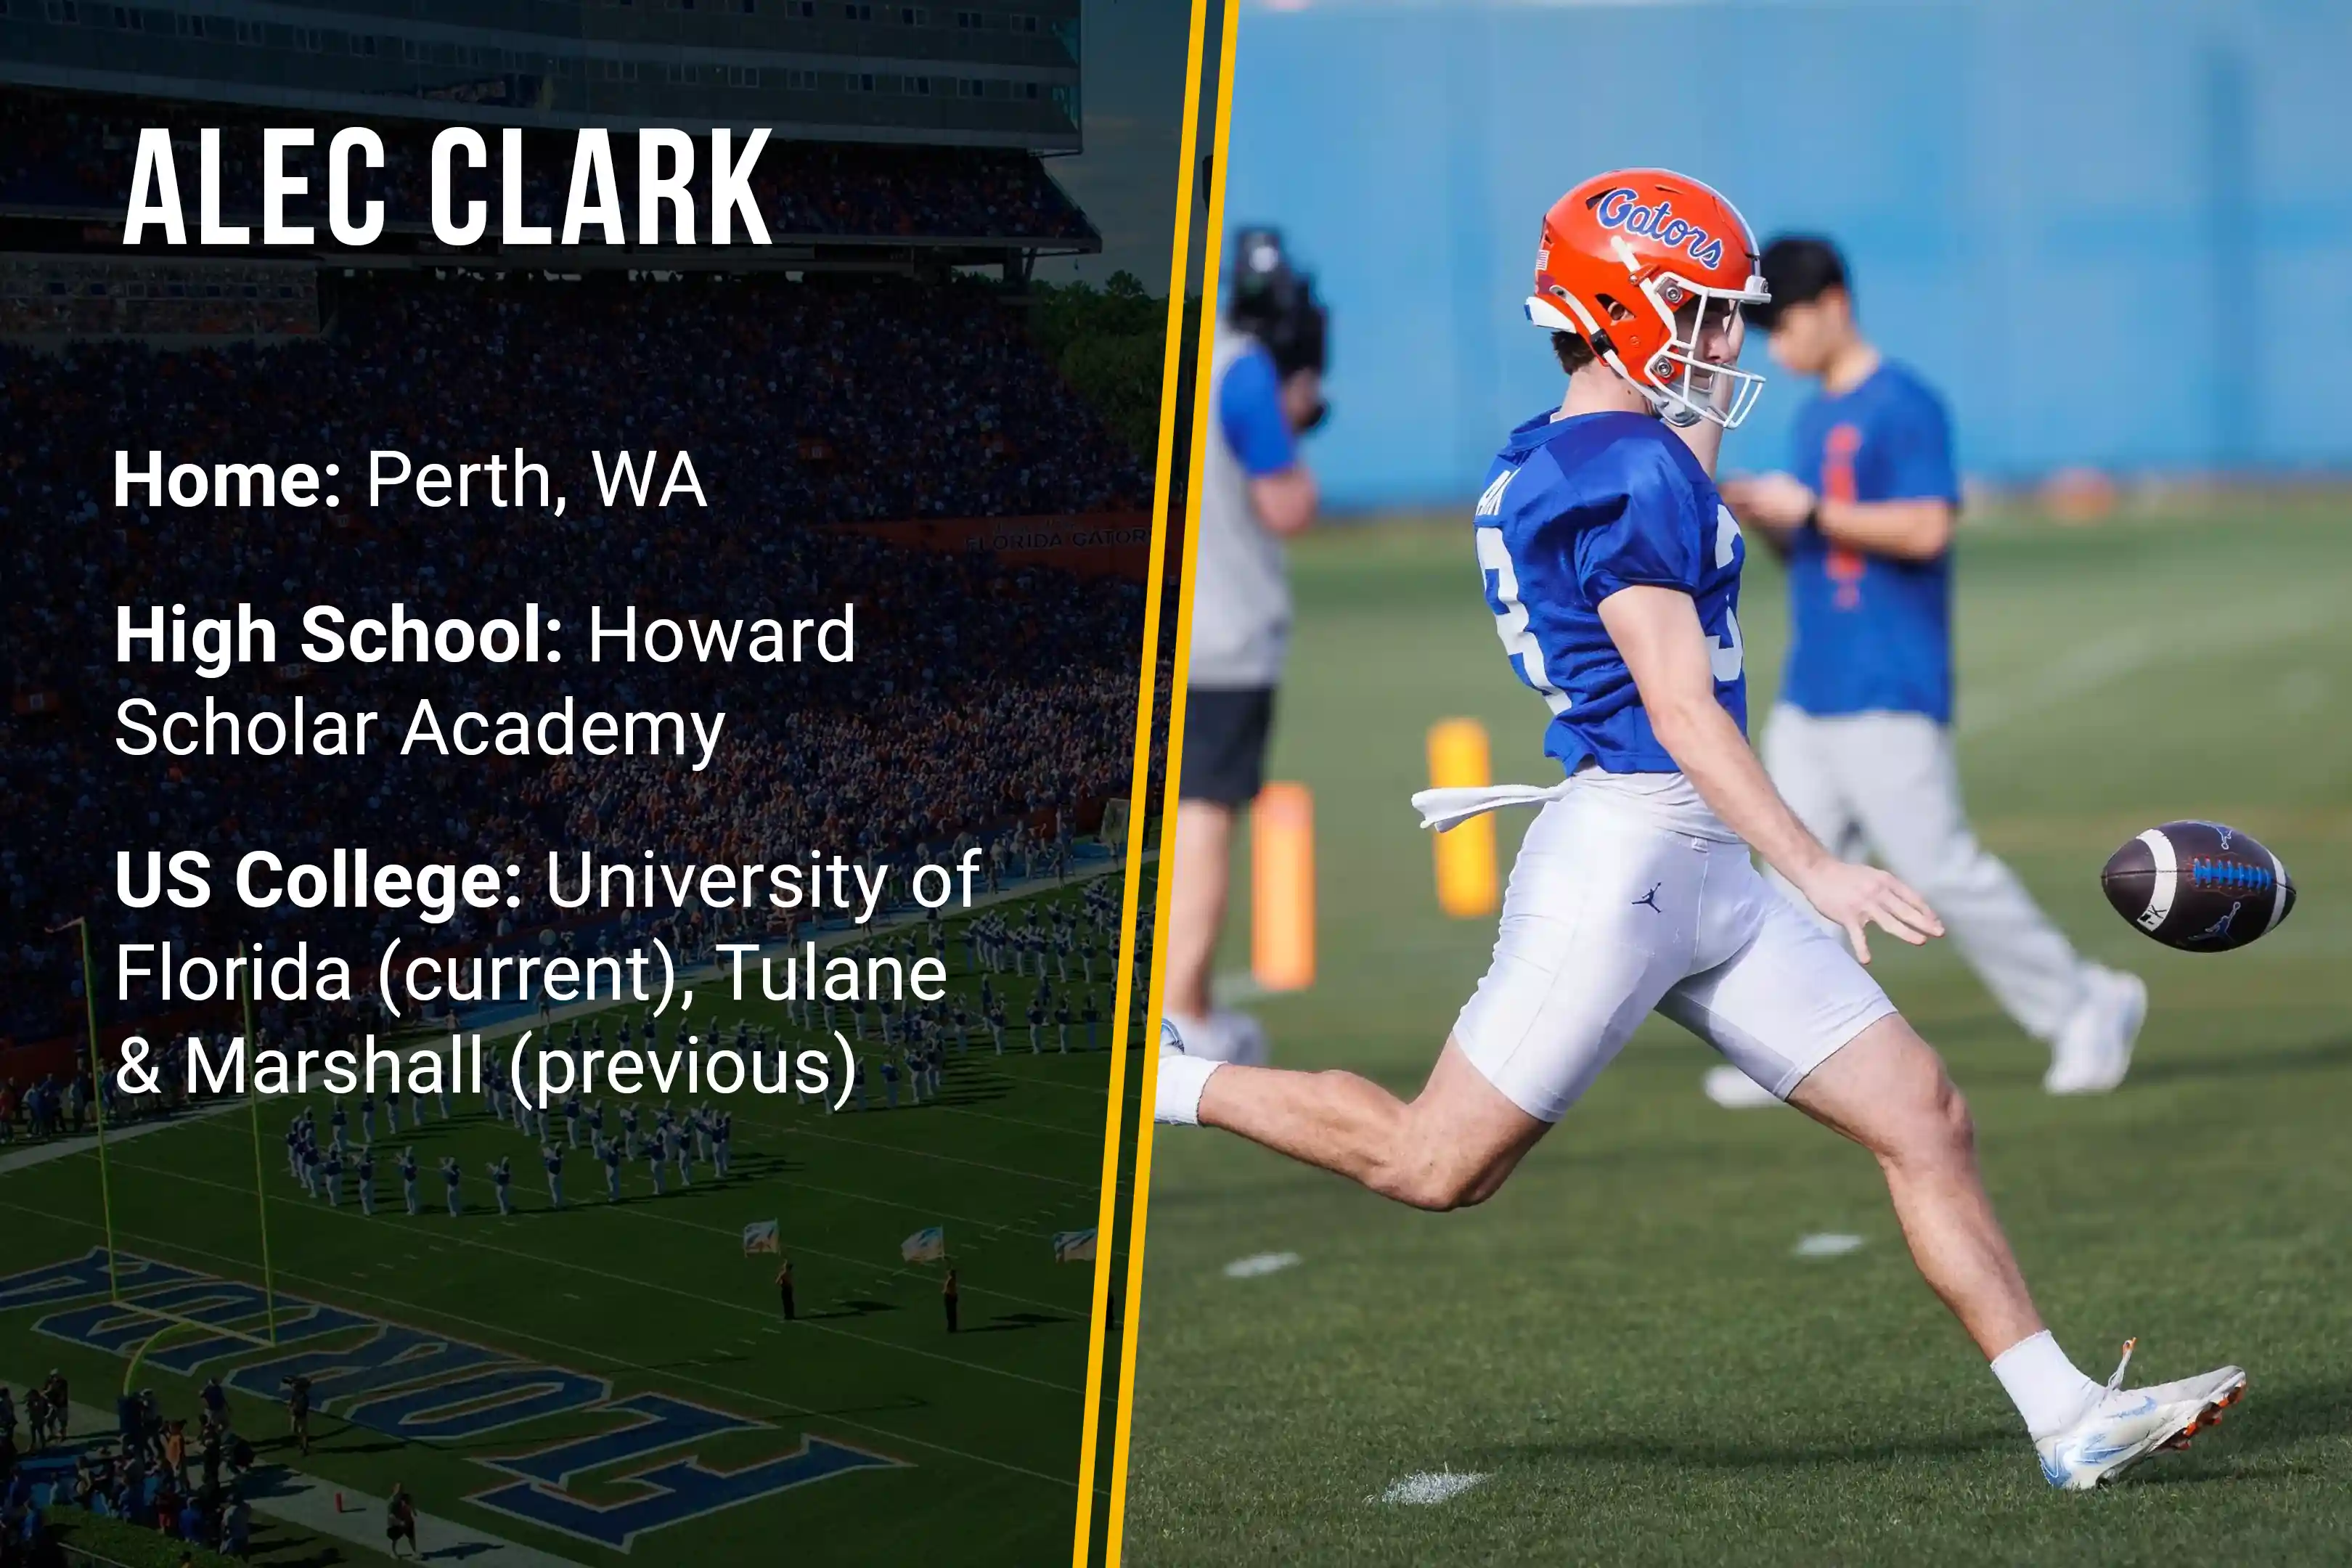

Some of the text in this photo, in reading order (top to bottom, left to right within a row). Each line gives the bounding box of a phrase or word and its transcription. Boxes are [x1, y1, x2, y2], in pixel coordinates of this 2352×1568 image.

[1596, 187, 1725, 271] Gators
[965, 528, 1151, 552] FLORIDA GATOR
